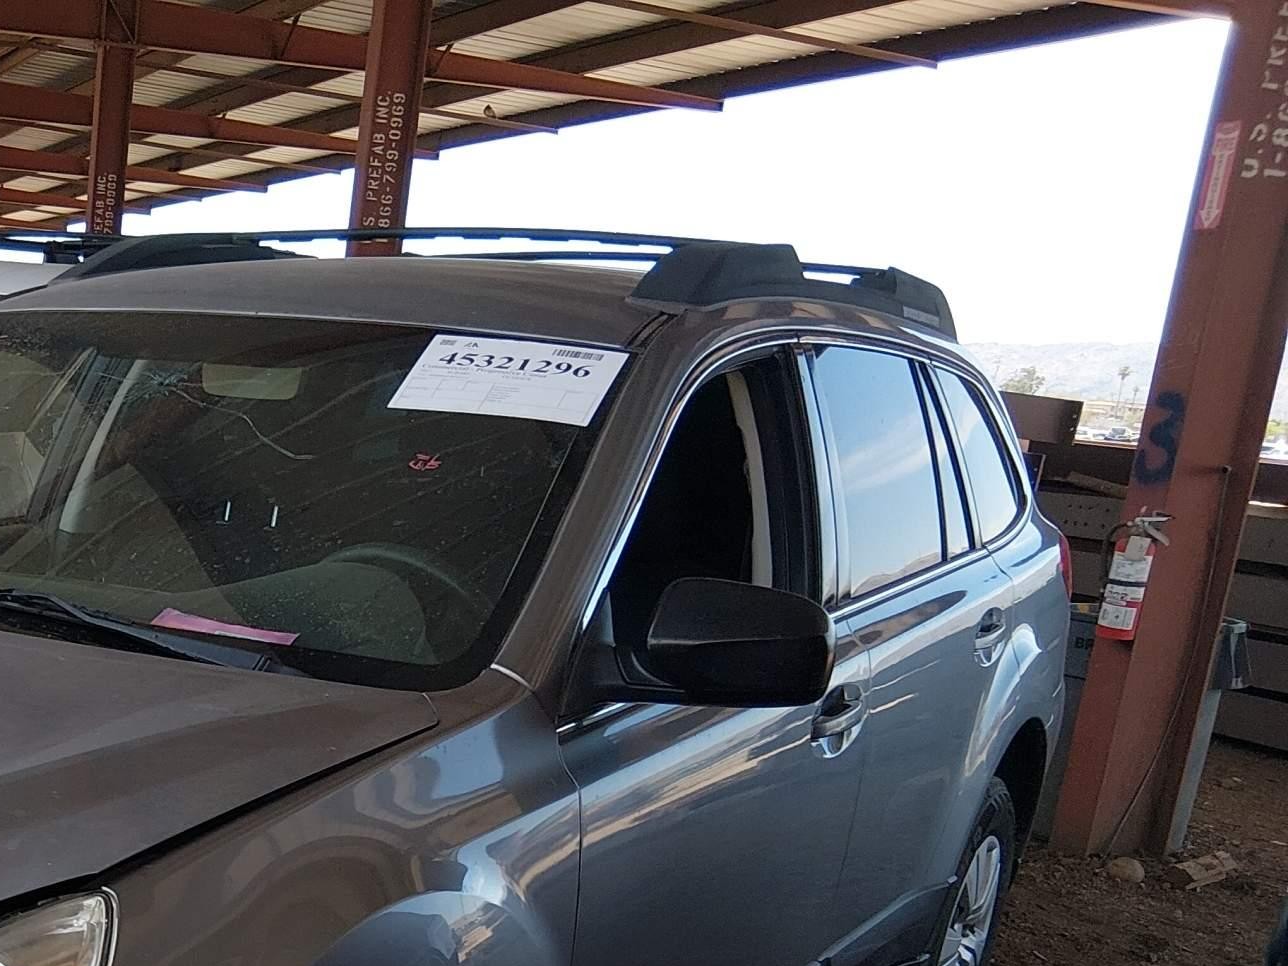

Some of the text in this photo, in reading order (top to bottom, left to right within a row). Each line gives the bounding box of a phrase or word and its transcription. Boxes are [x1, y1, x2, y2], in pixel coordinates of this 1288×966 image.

[366, 133, 386, 201] PREFAB
[376, 91, 392, 124] INC.
[375, 93, 406, 243] 1866-799-0969
[438, 351, 593, 378] 45321296
[1133, 390, 1186, 485] 3
